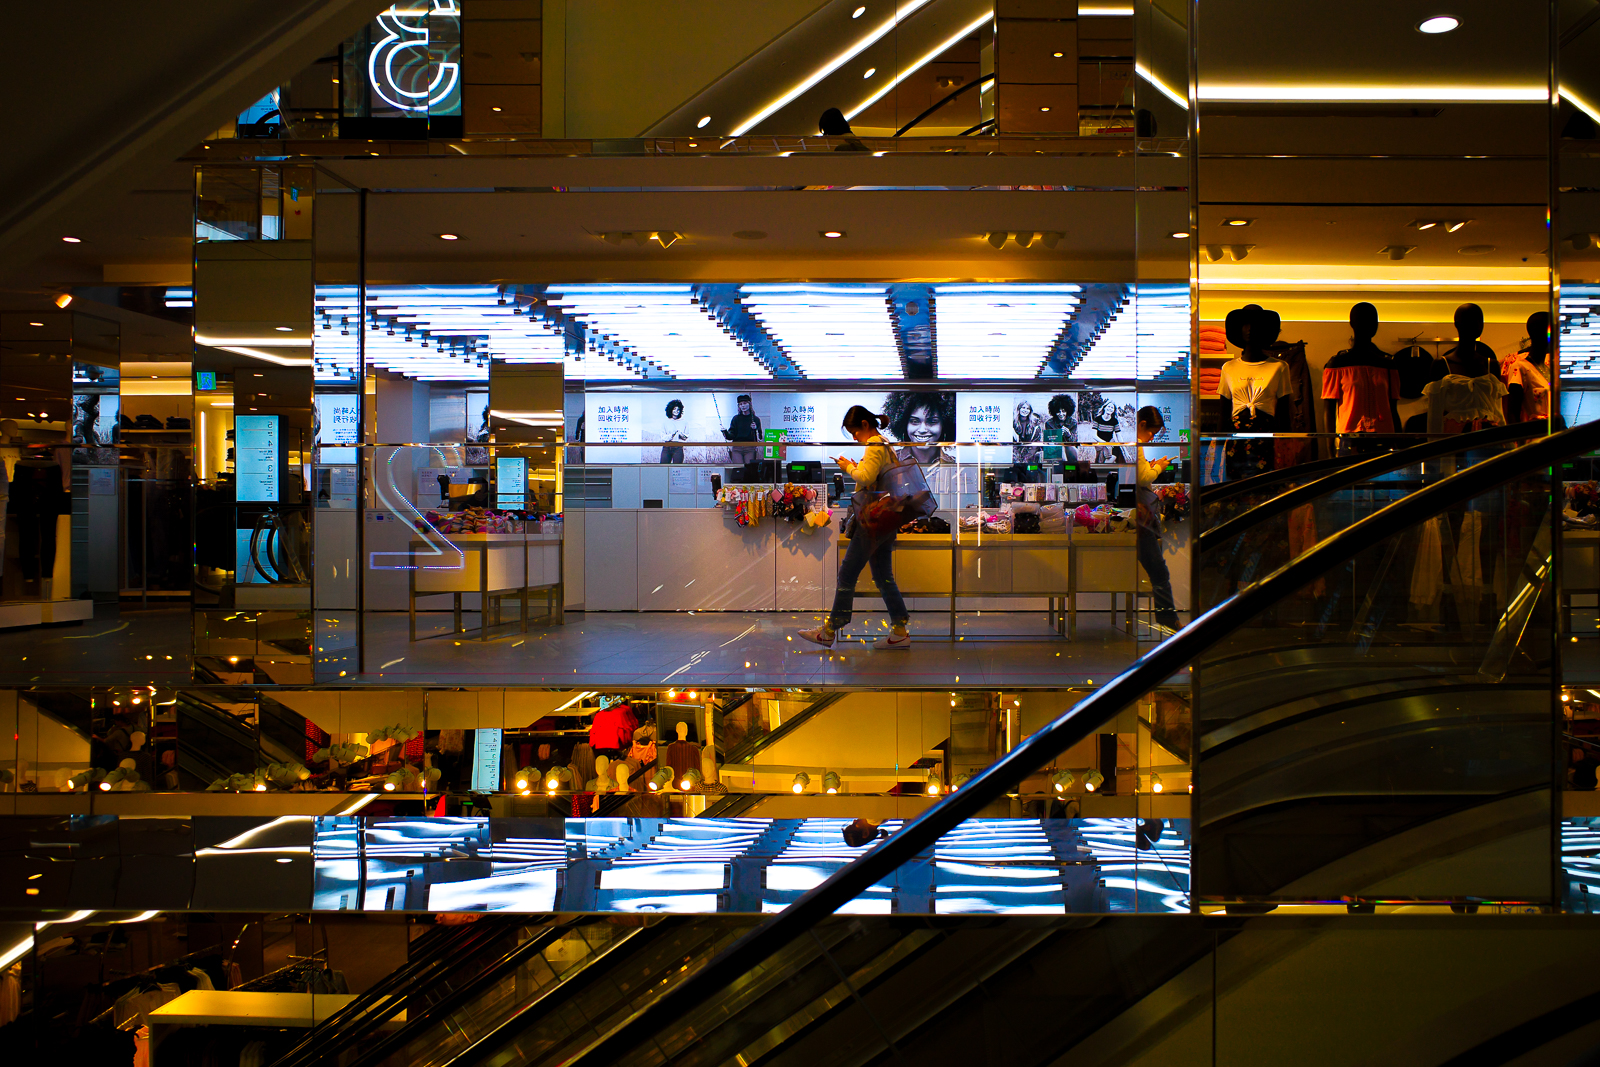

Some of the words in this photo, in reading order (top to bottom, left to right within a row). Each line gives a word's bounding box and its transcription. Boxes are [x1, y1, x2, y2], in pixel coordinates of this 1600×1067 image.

[783, 414, 815, 422] 回收行列
[968, 414, 1000, 422] 回收行列
